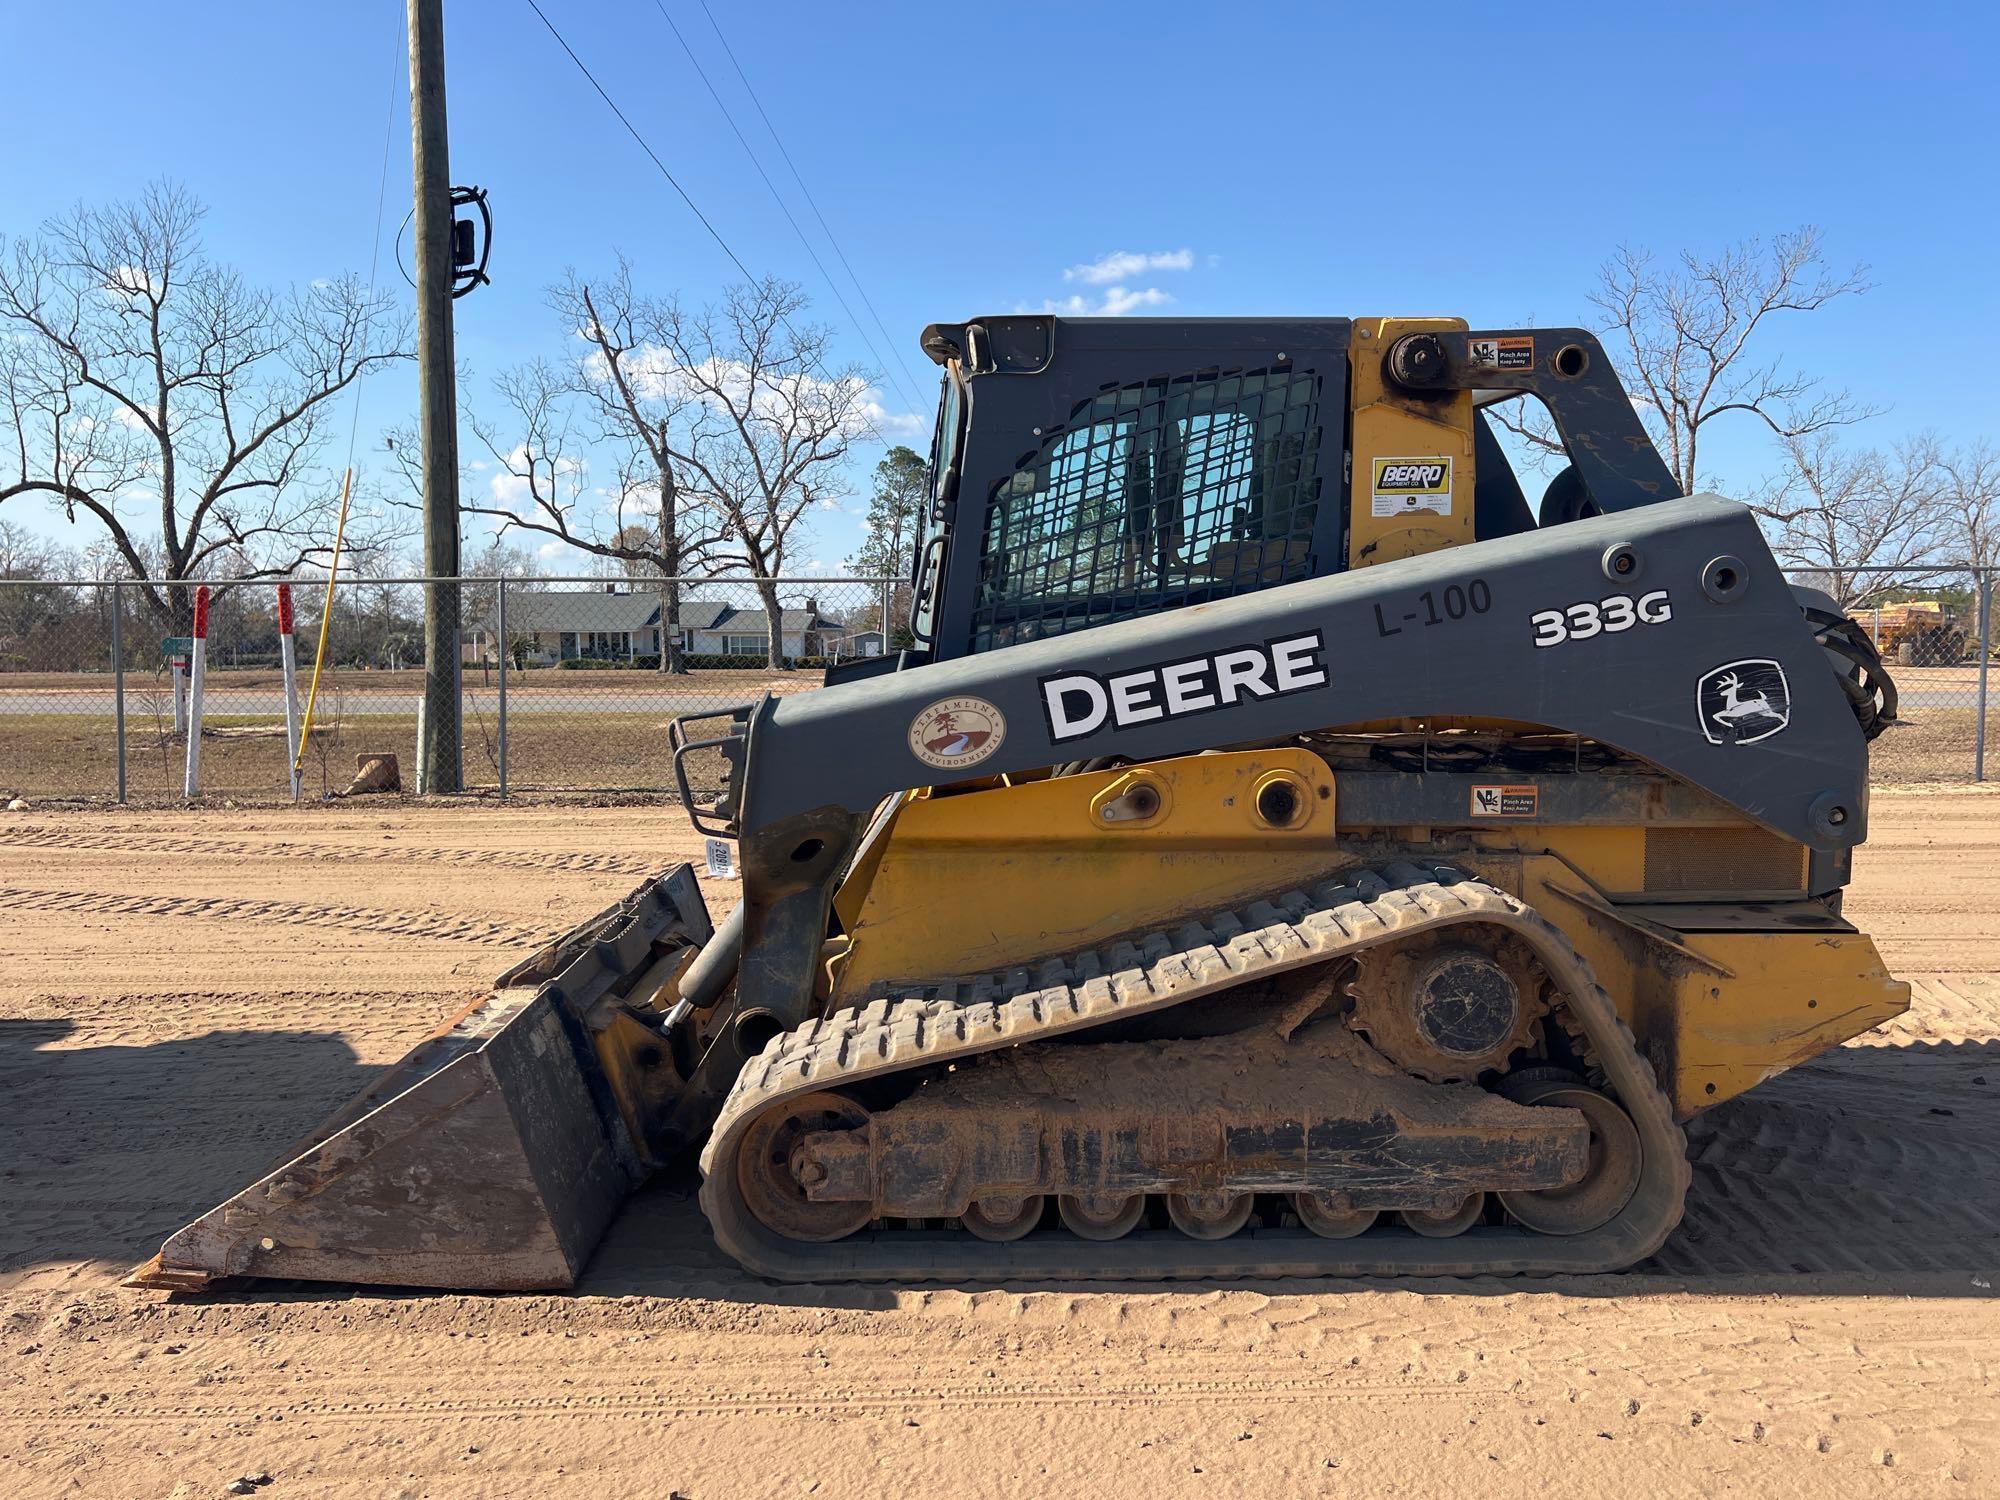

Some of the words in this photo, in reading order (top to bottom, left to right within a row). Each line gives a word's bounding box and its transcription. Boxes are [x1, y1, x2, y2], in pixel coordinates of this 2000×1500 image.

[1382, 465, 1442, 489] BEARD
[1373, 578, 1492, 638] L-100
[1531, 590, 1672, 647] 333G
[1043, 635, 1326, 741] DEERE
[912, 701, 999, 737] STREAMLINE
[920, 733, 1001, 766] ENVIRONMENTAL
